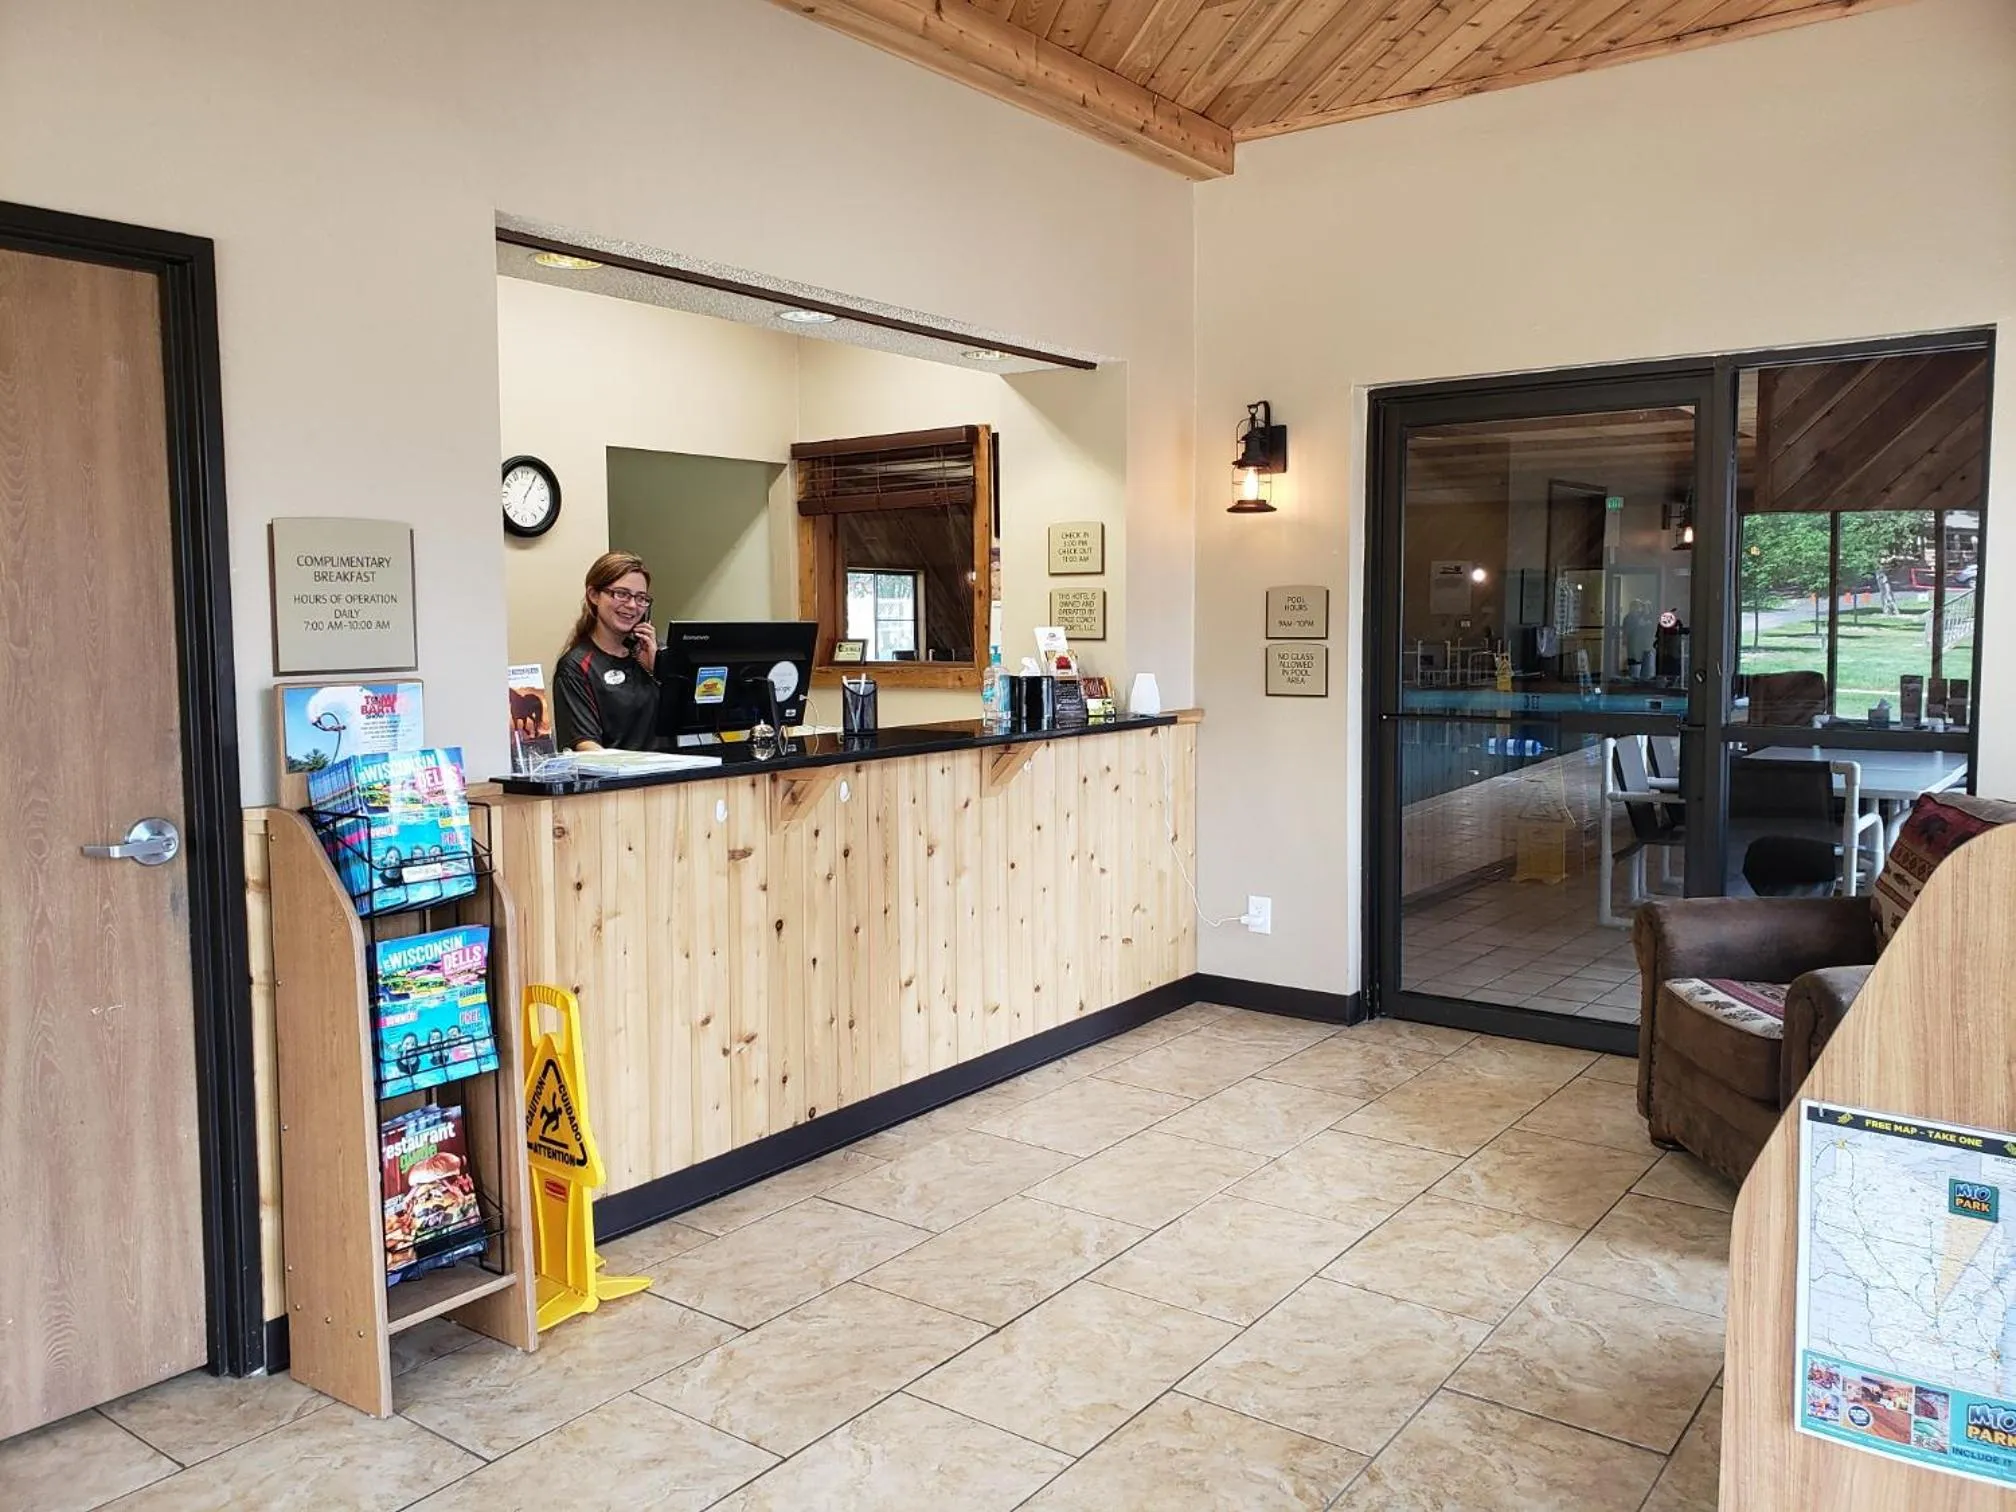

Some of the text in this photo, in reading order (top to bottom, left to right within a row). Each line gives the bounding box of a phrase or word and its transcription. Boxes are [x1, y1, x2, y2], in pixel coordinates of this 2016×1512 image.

[296, 555, 392, 568] COMPLIMENTARY
[313, 570, 376, 583] BREAKFAST
[293, 594, 398, 604] HOURS OF OPERATION
[333, 608, 361, 619] DAILY
[375, 620, 391, 630] AM
[389, 935, 463, 970] WISCONSIN
[443, 945, 481, 969] DELLS
[525, 1077, 582, 1142] CAUTION CUIDADO
[1865, 1119, 1892, 1131] FREE
[1894, 1125, 1918, 1135] MAP
[1927, 1130, 1957, 1143] TAKE
[1959, 1136, 1983, 1147] ONE
[532, 1145, 576, 1167] ATTENTION
[1955, 1198, 1990, 1212] PARK
[1952, 1446, 2012, 1467] INCLUDE IT
